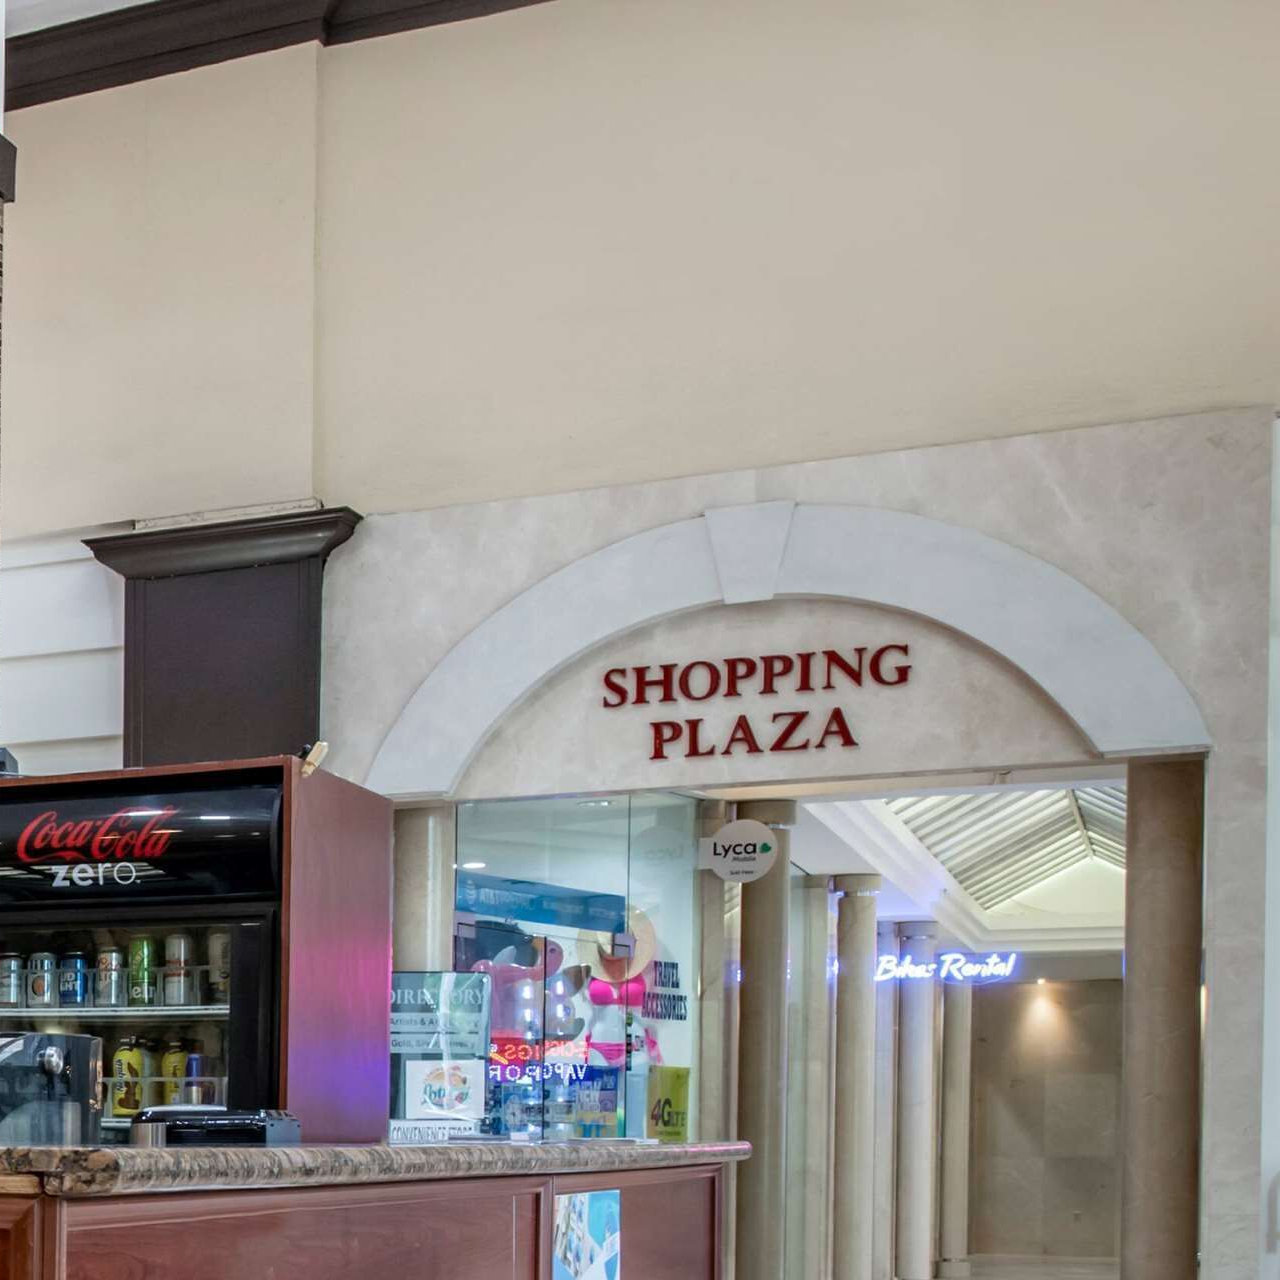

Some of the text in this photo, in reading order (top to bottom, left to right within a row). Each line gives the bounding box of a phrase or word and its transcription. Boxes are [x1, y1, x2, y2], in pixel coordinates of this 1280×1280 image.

[602, 644, 912, 708] SHOPPING
[648, 707, 859, 760] PLAZA
[17, 805, 177, 863] Coca-Cola
[713, 842, 757, 858] Lyca
[51, 861, 137, 887] zero
[654, 960, 679, 988] TRAVEL
[939, 952, 1017, 981] Rental
[390, 988, 484, 1006] DIREORY
[641, 992, 687, 1020] ACCESSORIES
